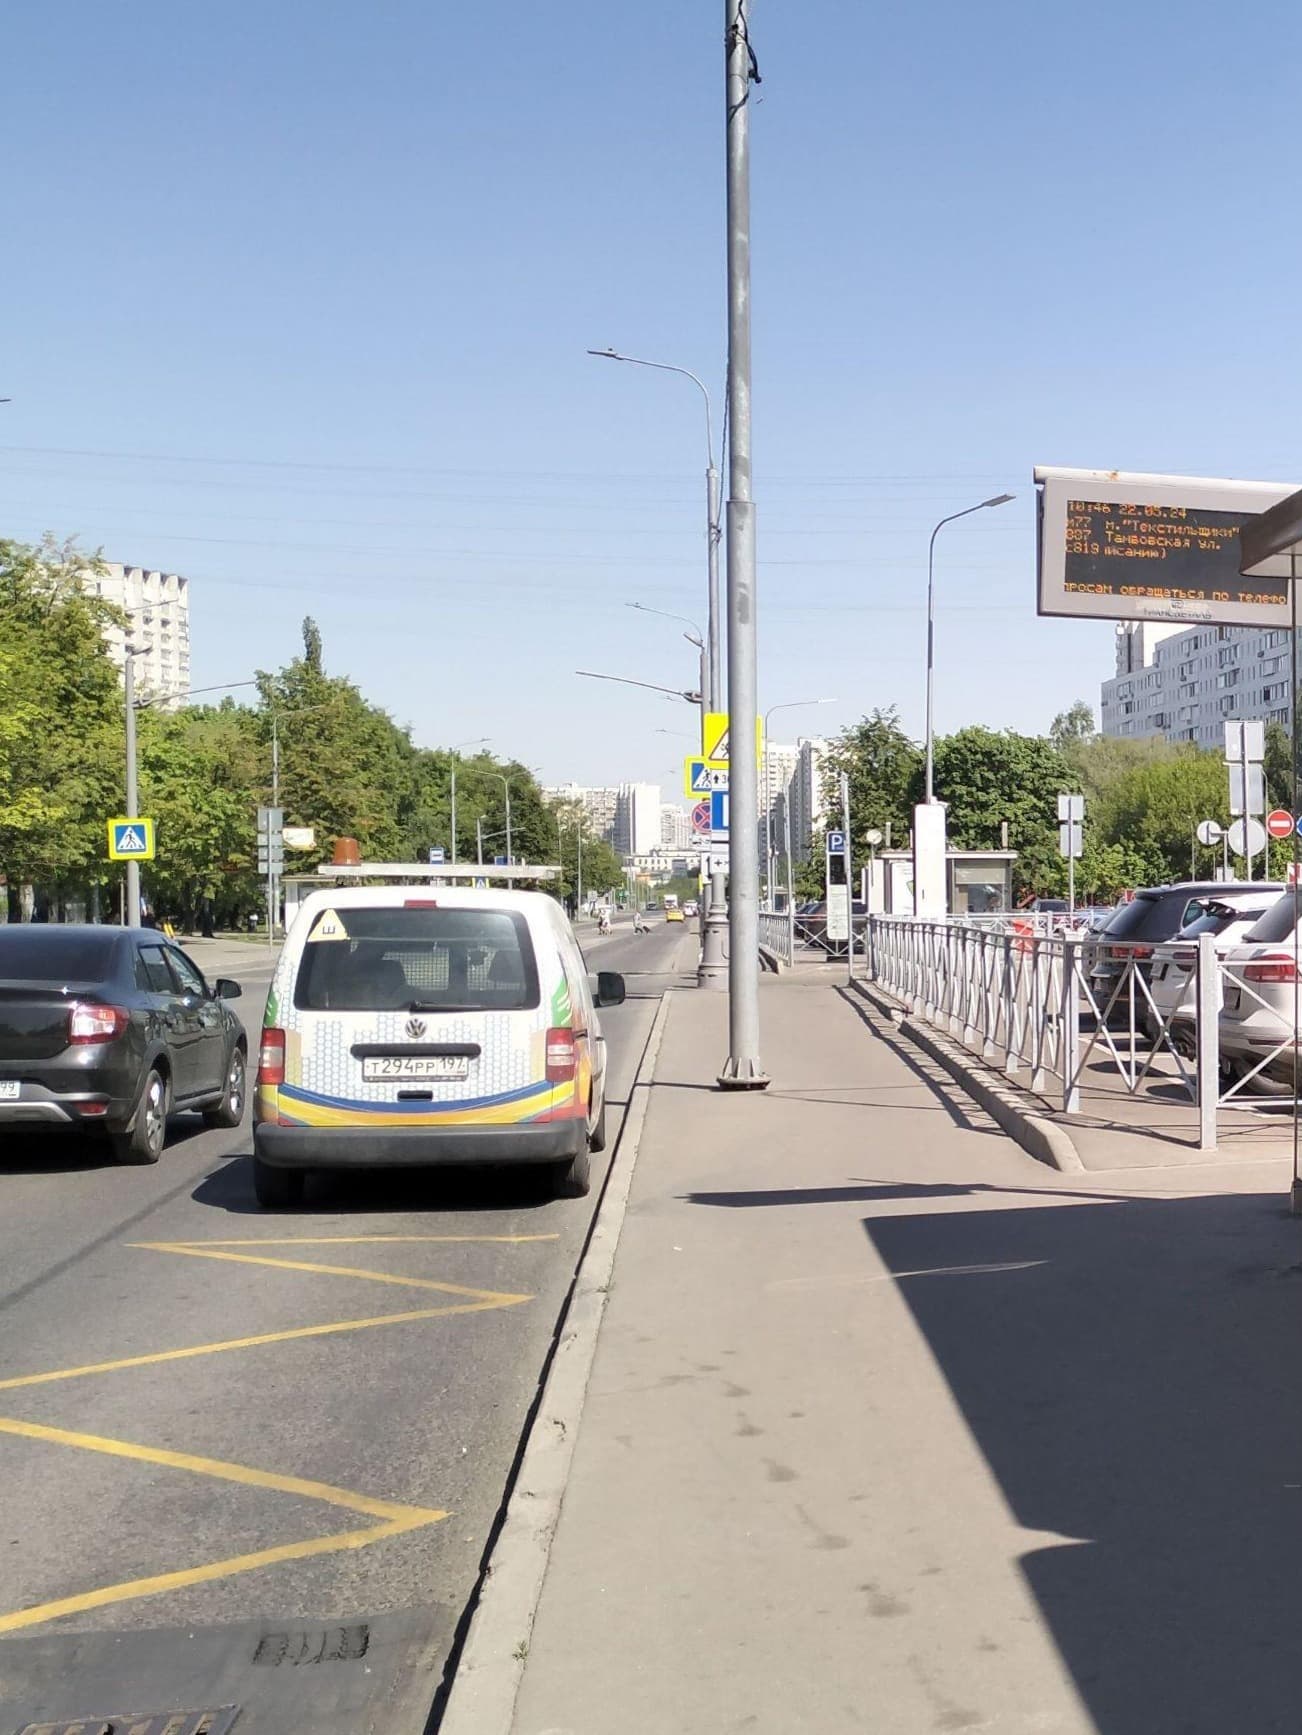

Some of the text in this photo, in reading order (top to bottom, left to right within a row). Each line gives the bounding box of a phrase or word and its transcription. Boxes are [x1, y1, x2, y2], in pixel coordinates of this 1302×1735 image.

[1119, 503, 1187, 519] 22.05.24
[1123, 518, 1240, 538] "Текстильщики"
[1198, 539, 1221, 550] ул.
[1119, 586, 1205, 600] обращаться
[1212, 591, 1230, 602] по
